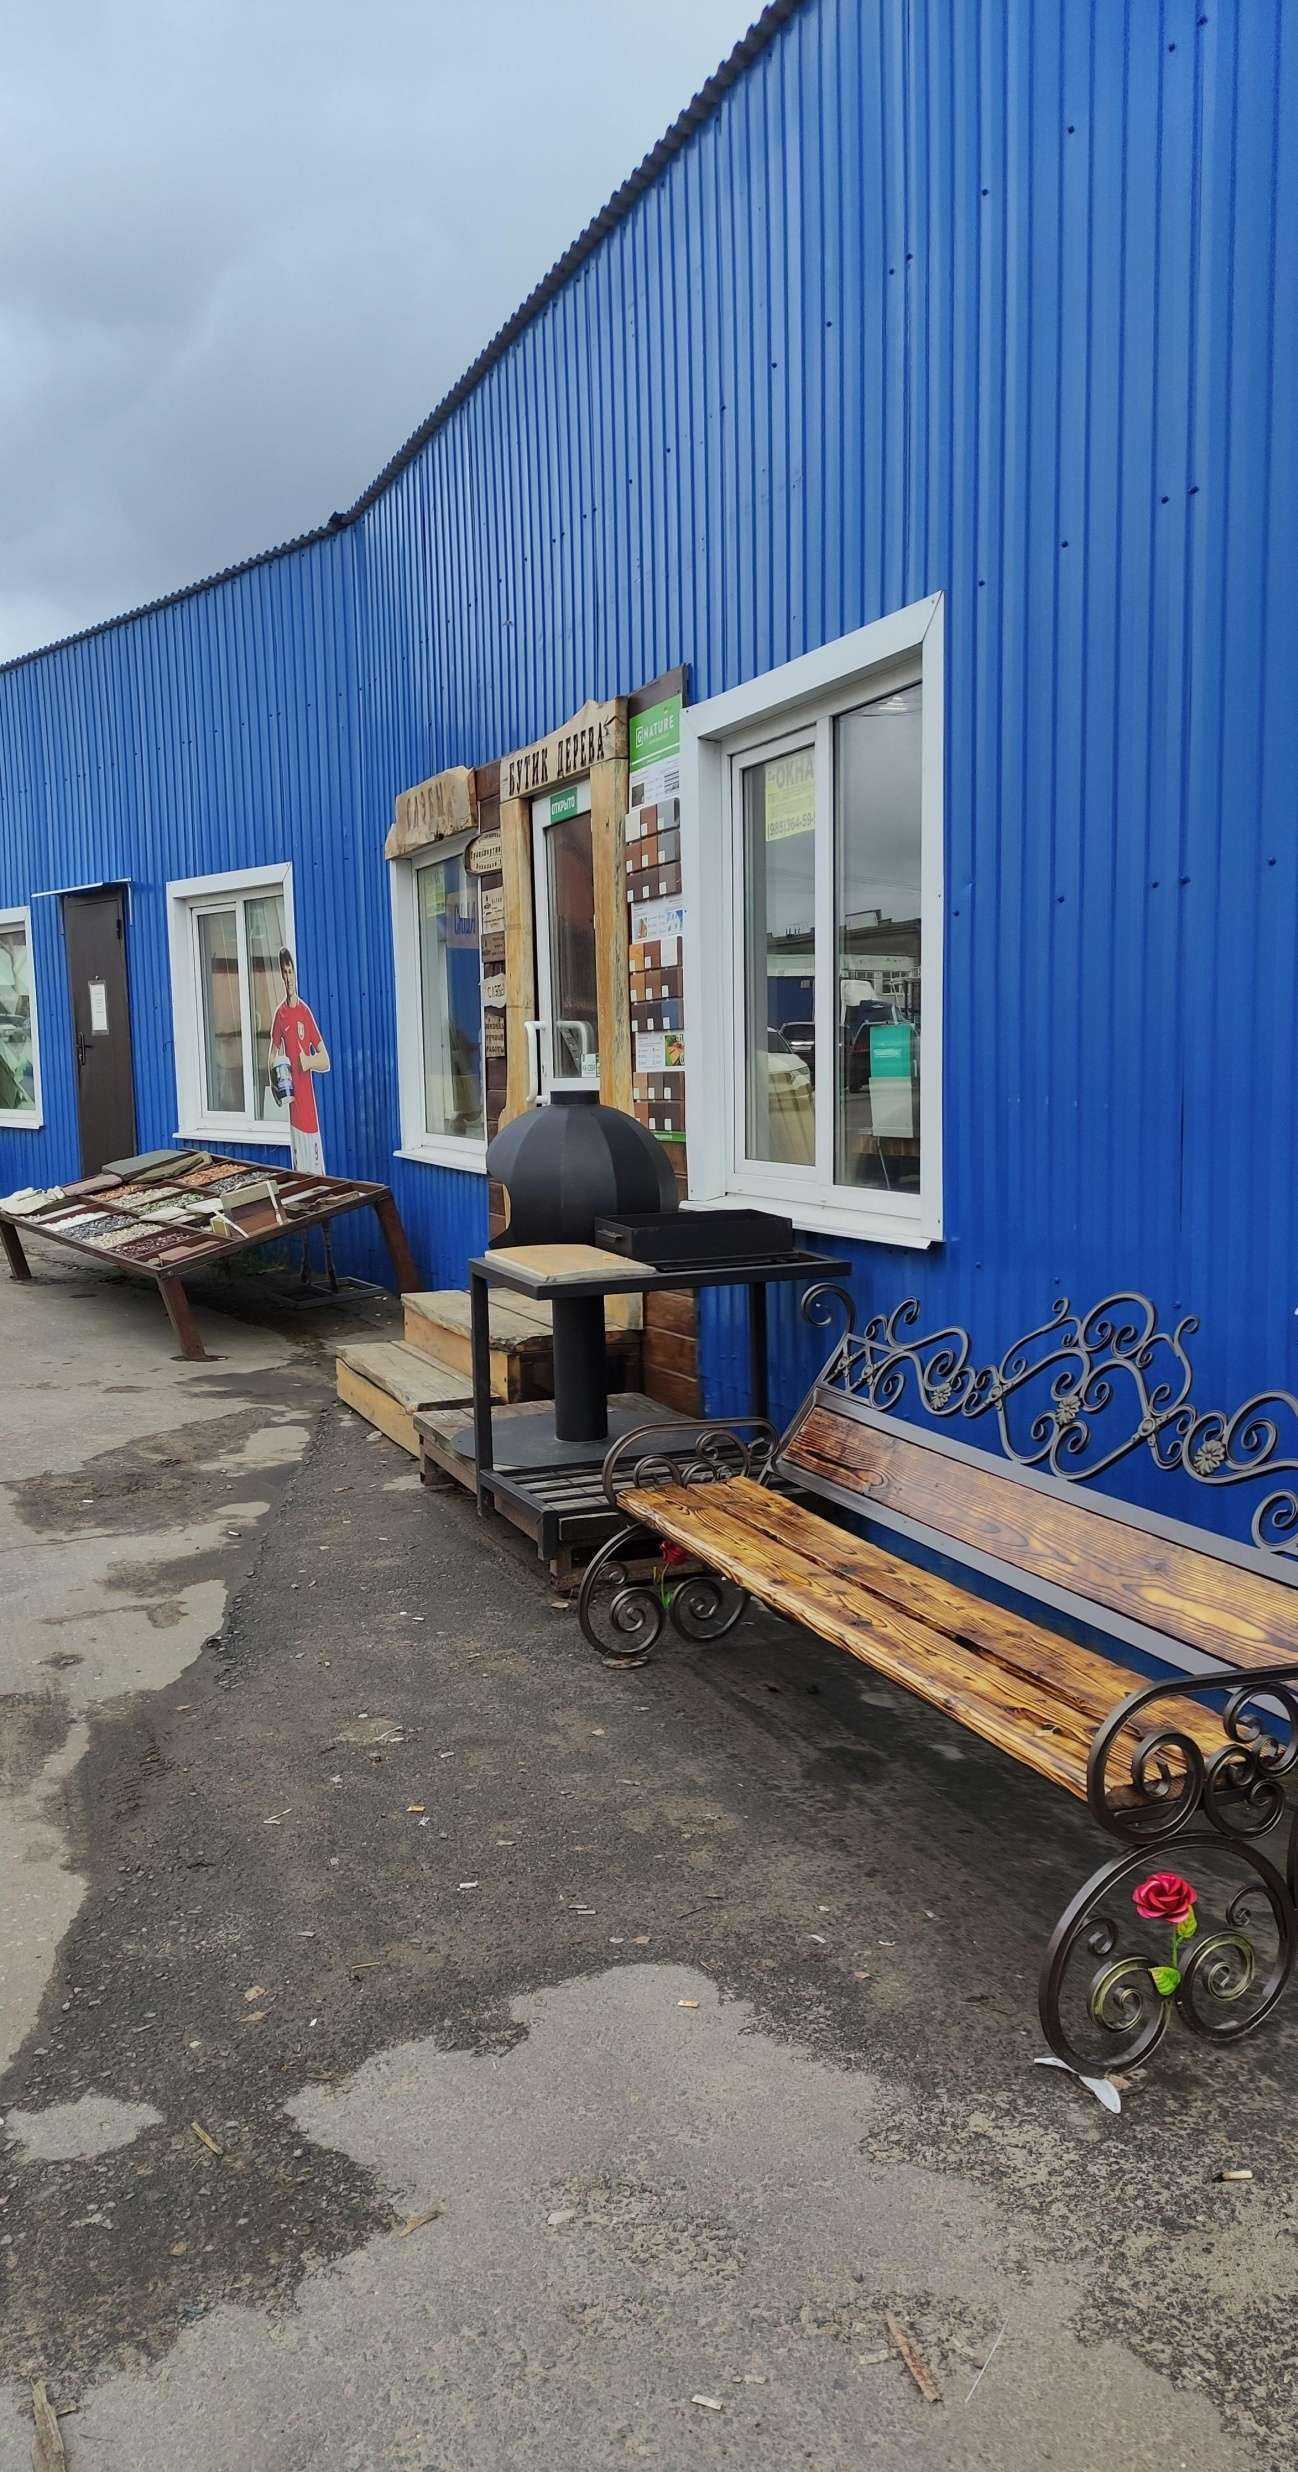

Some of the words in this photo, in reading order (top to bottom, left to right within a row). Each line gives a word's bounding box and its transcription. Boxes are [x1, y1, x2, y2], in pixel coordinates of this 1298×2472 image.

[509, 747, 548, 797] БУТИК
[557, 722, 605, 780] ДЕРЕВА
[551, 796, 576, 815] ОТКРЫТО
